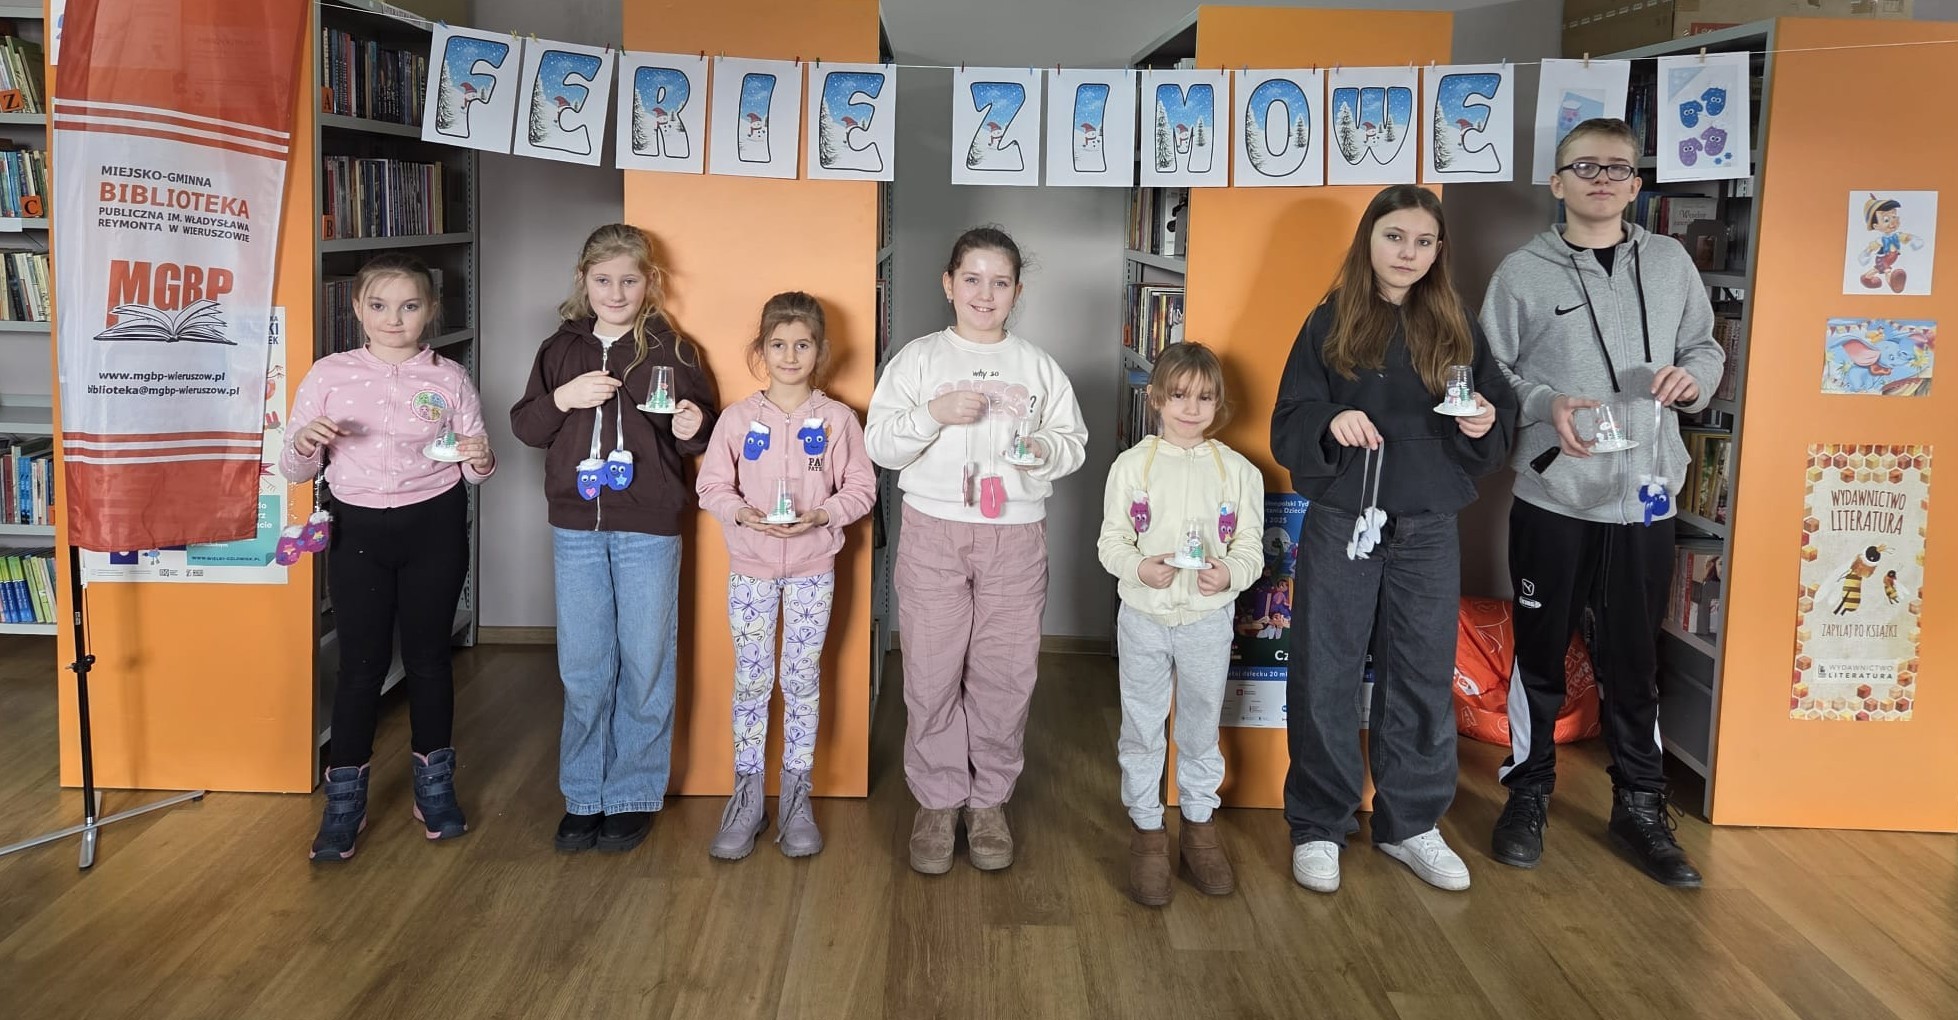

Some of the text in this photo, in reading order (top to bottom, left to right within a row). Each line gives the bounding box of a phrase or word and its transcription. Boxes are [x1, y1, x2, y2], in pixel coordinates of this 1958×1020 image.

[3, 93, 21, 110] Z
[324, 92, 332, 111] A
[436, 35, 885, 173] FERIE
[966, 73, 1502, 178] ZIMOWE
[101, 165, 212, 188] MIEJSKO-GMINNA
[24, 200, 39, 215] C
[100, 181, 250, 220] BIBLIOTEKA
[99, 206, 250, 232] PUBLICZNA IM. WŁADYSŁAWA
[326, 219, 333, 237] B
[98, 218, 250, 243] REYMONTA W WIERUSZOWIE
[106, 259, 234, 329] MGBP
[98, 371, 226, 382] www.mgbp-wieruszow.pl
[972, 368, 988, 380] why
[87, 384, 240, 396] biblioteka@mgbp-wieruszow.pl
[1831, 489, 1906, 511] WYDAWNICTWO
[1831, 510, 1904, 535] LITERATURA
[1854, 624, 1864, 637] PO
[1865, 623, 1898, 639] KSIĄŻKI
[1269, 670, 1278, 678] 20
[1828, 664, 1894, 672] WYDAWNICTWO
